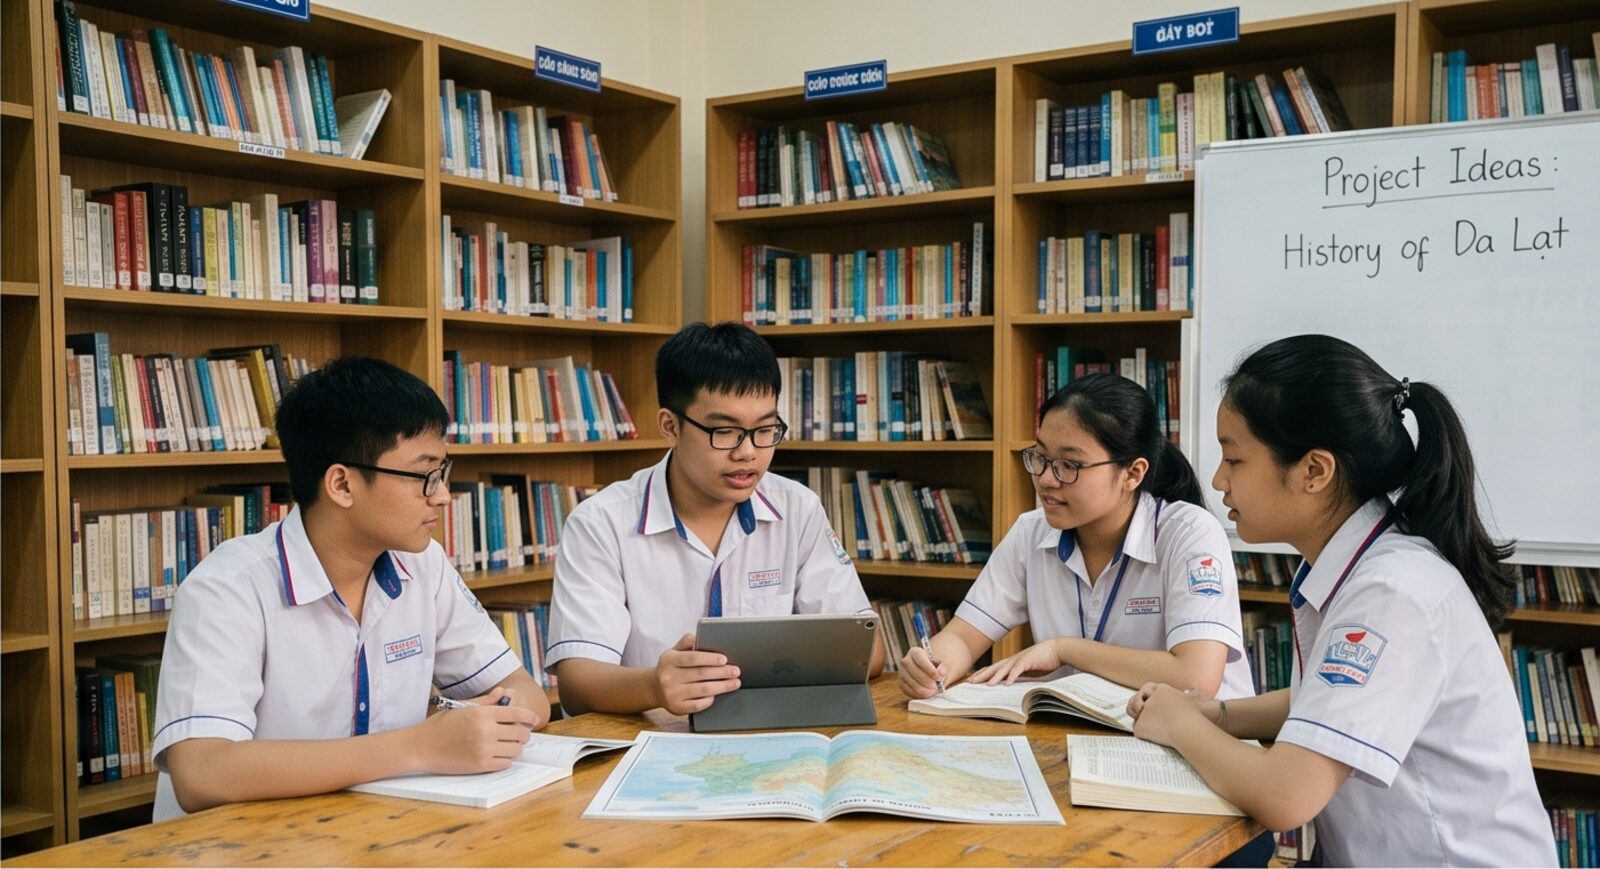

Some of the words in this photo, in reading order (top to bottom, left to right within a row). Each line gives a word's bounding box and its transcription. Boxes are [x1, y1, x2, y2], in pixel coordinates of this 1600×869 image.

[1325, 155, 1426, 208] Project
[1284, 233, 1381, 278] History
[1401, 236, 1429, 272] of
[1455, 219, 1494, 256] Da
[1513, 216, 1569, 260] Lạt
